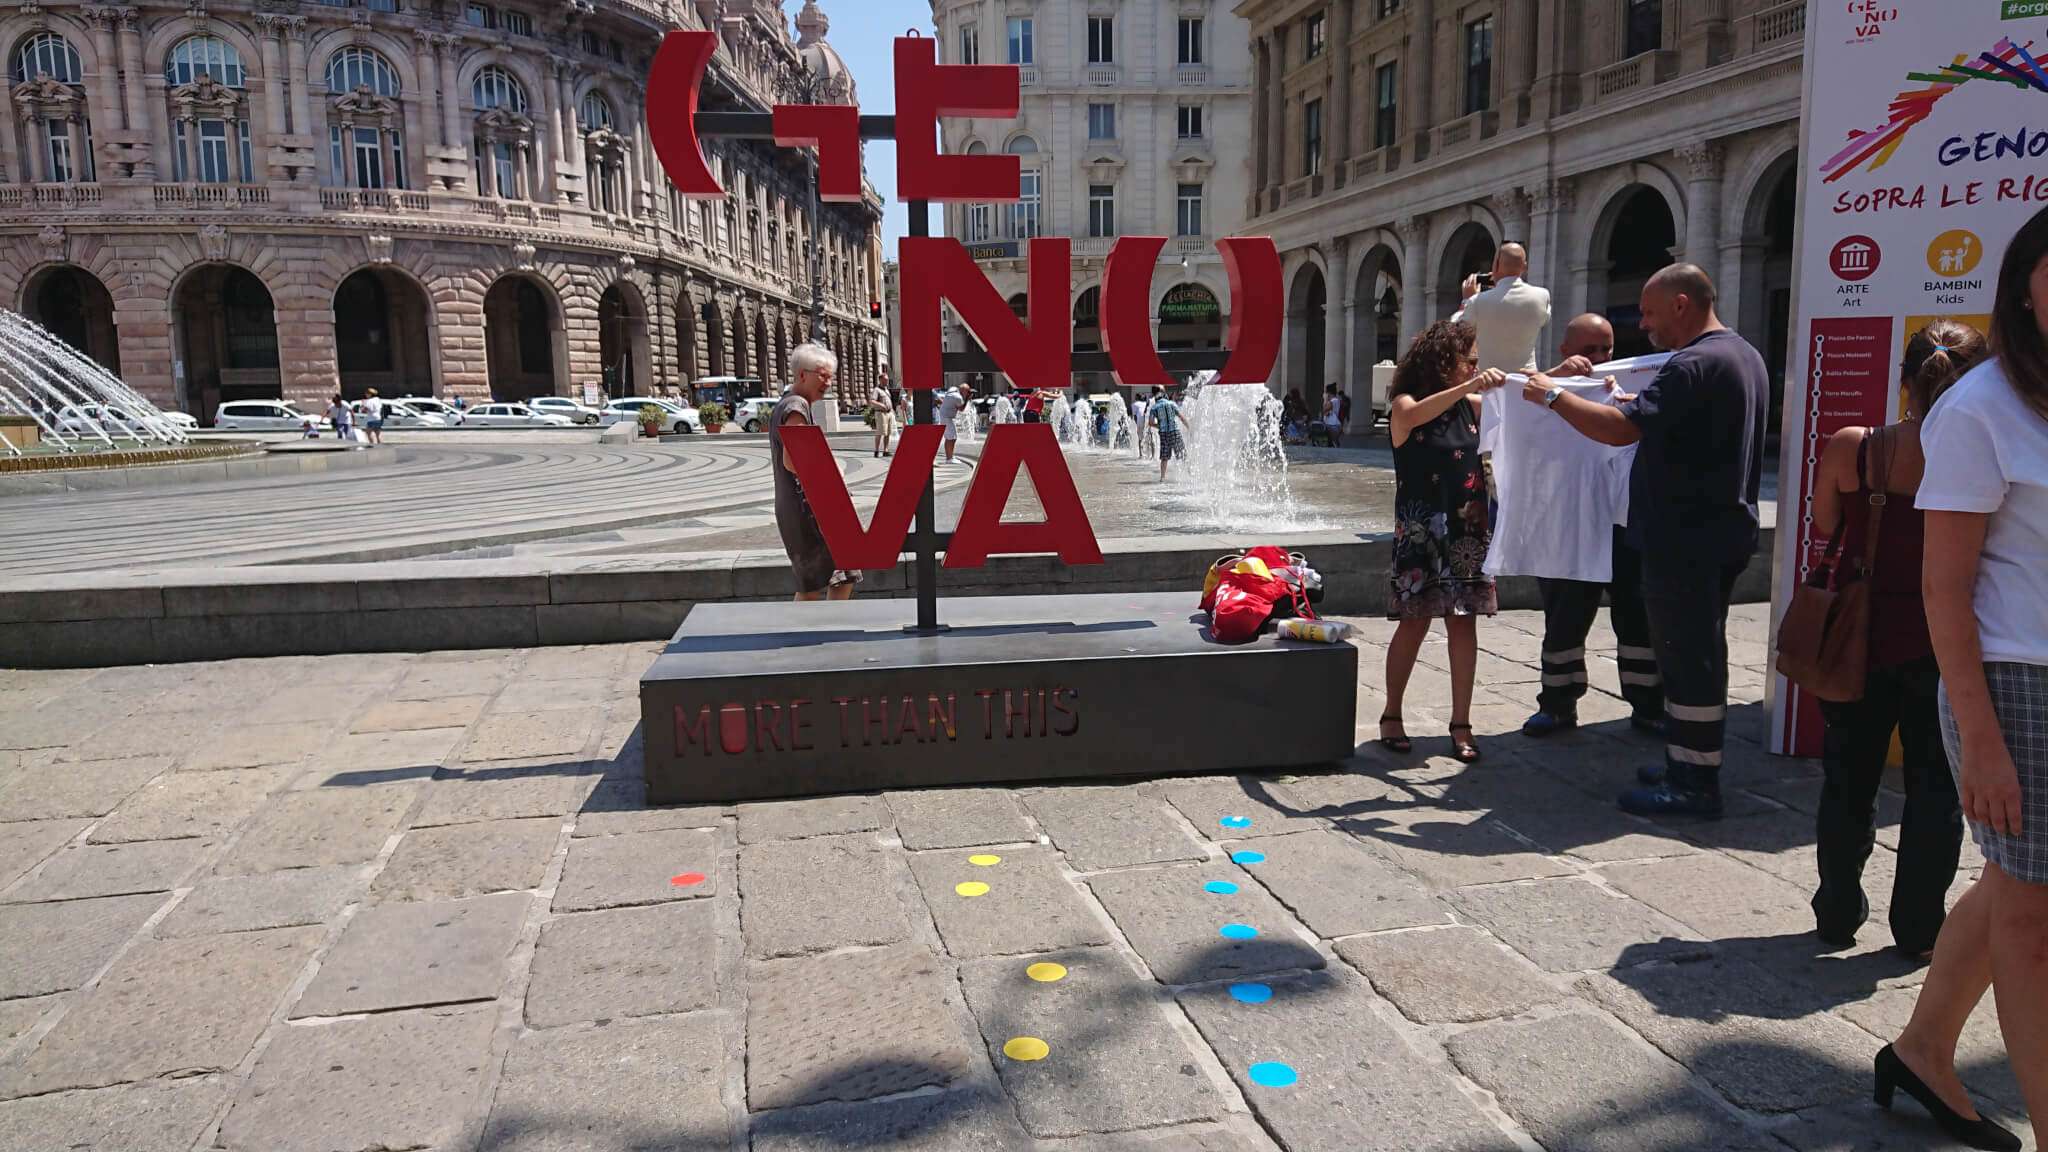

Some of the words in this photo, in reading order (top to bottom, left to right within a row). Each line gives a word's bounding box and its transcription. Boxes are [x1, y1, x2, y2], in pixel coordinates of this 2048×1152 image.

[1832, 184, 1926, 214] SOPRA
[1940, 181, 1984, 208] LE
[973, 246, 1004, 258] Banca
[1836, 284, 1870, 295] ARTE
[1924, 279, 1982, 292] BAMBINI
[1843, 297, 1861, 307] Art
[1936, 293, 1965, 304] Kids
[779, 423, 1105, 569] VA
[673, 698, 813, 758] MORE
[832, 691, 957, 748] THAN
[975, 684, 1080, 740] THIS
